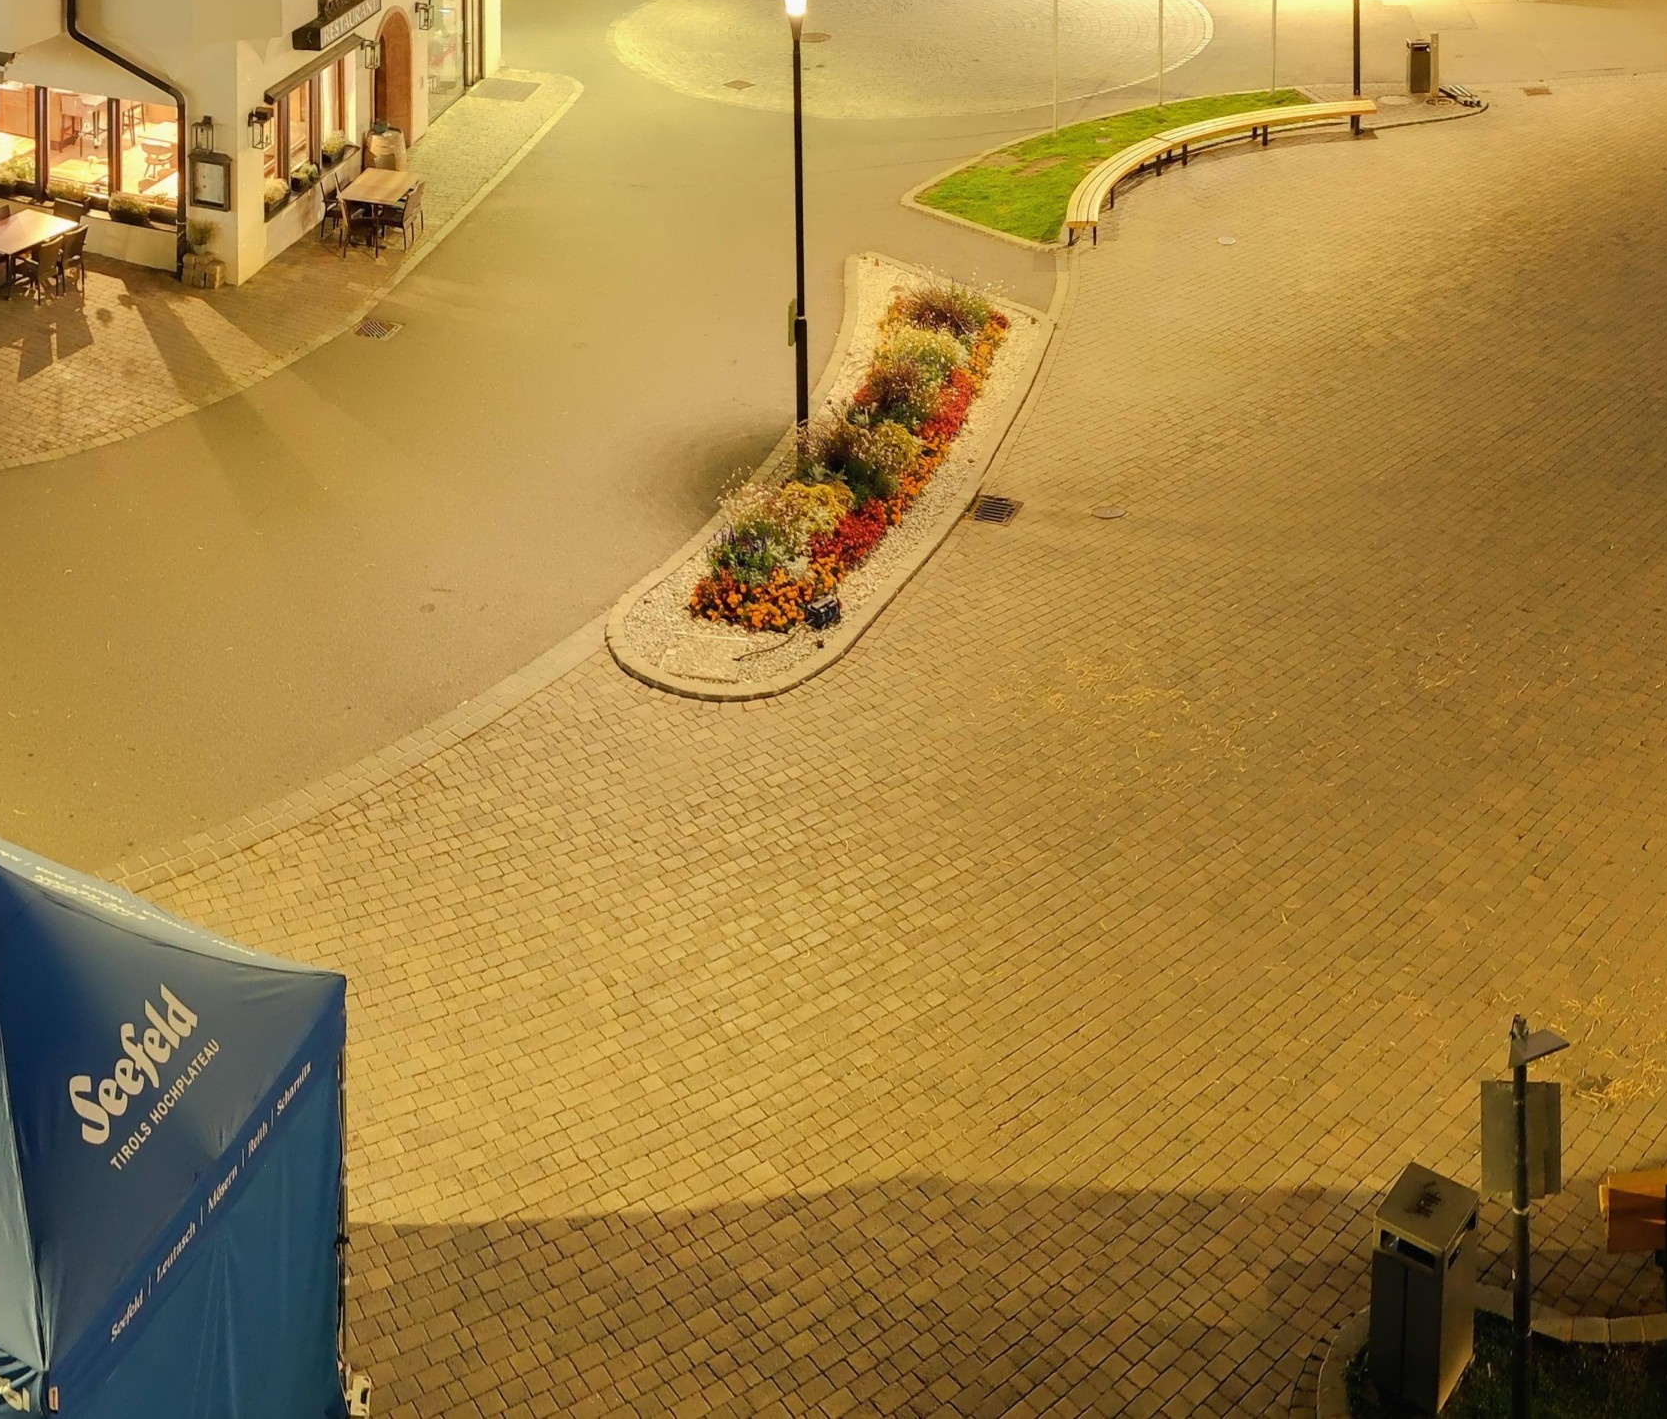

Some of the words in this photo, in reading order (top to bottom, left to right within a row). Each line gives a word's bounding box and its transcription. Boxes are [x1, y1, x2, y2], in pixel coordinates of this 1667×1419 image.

[69, 983, 199, 1145] Seefeld
[110, 1122, 152, 1171] TIROLS
[149, 1038, 221, 1125] HOCHPLATEAU
[110, 1288, 144, 1343] Seefeld
[156, 1221, 196, 1283] Leutasch
[207, 1164, 238, 1213] Mösern
[247, 1121, 268, 1158] Reith
[276, 1061, 312, 1116] Scharnitz
